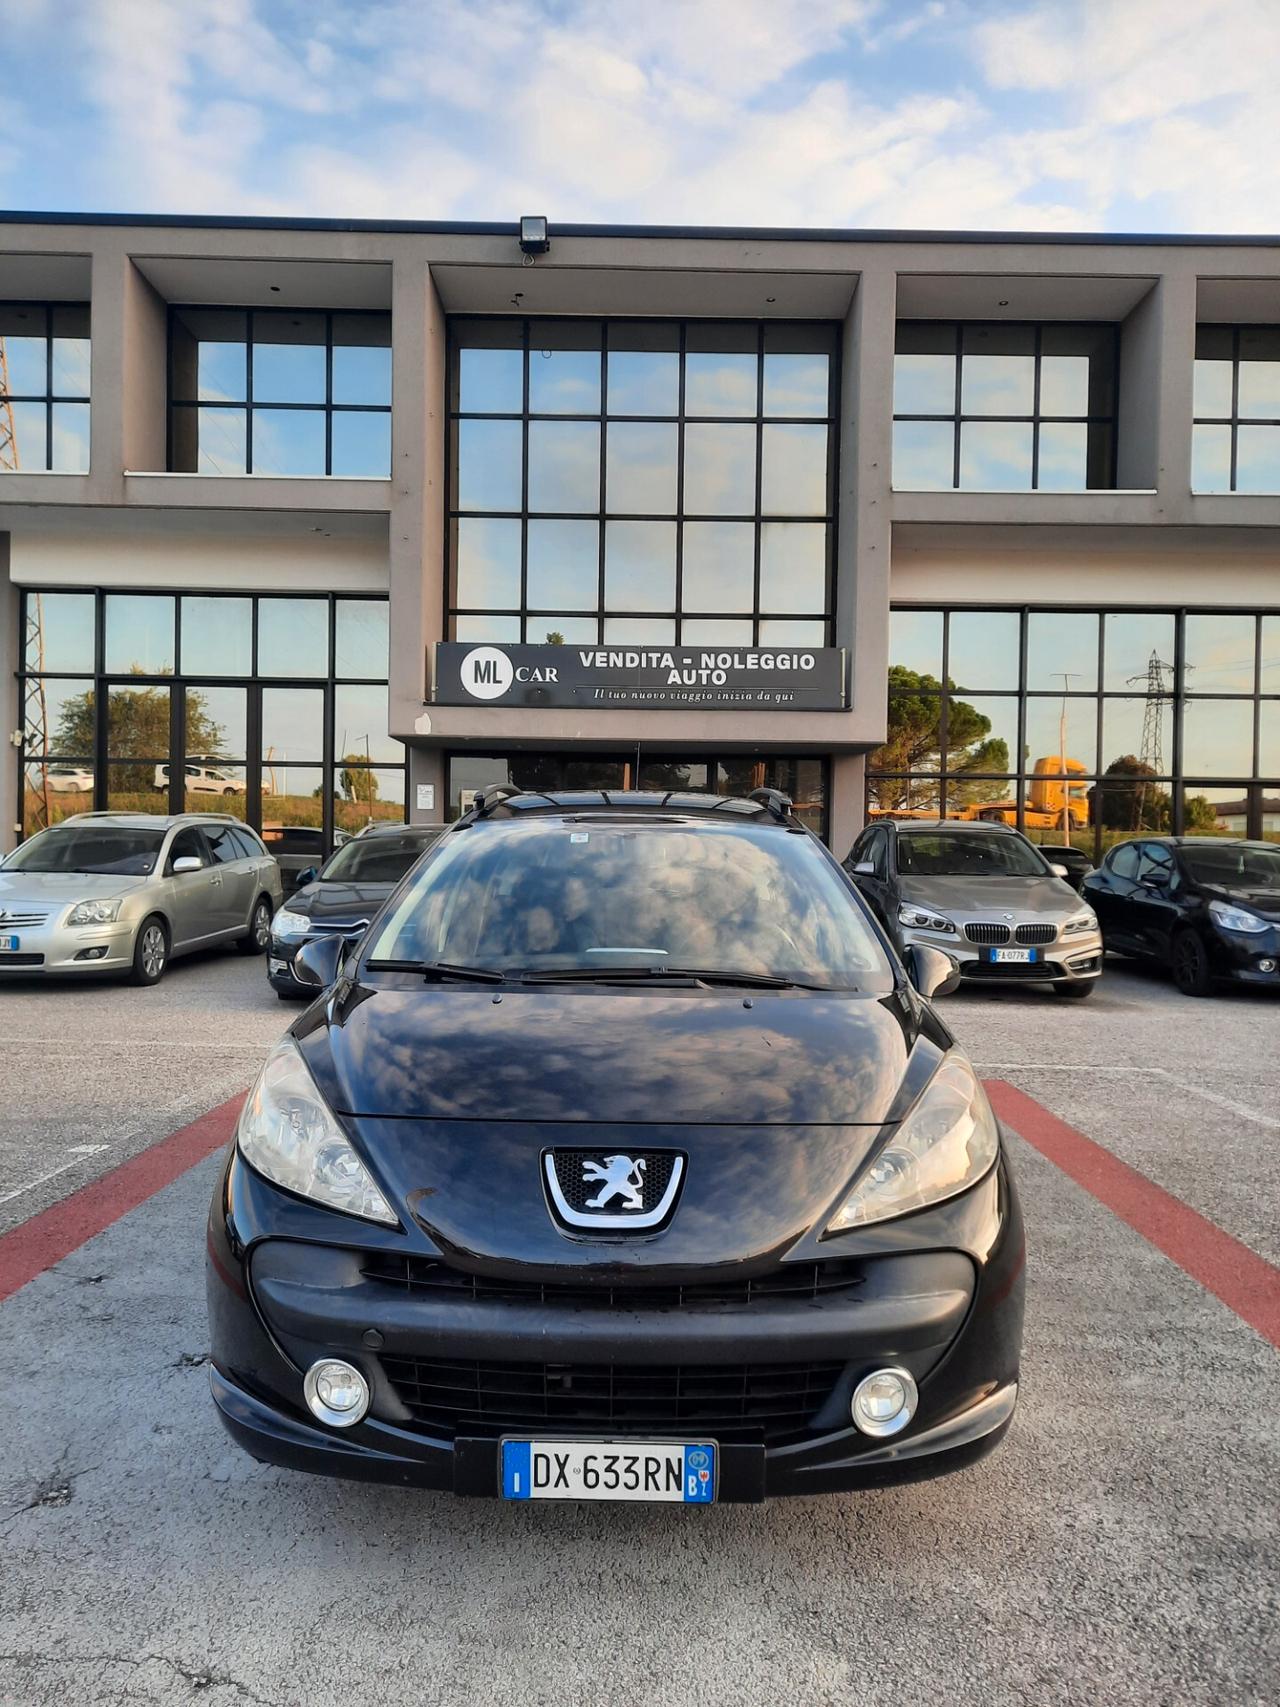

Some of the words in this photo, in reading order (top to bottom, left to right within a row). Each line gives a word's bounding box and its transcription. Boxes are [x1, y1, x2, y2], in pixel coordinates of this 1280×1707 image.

[579, 651, 675, 669] VENDITA
[701, 653, 815, 670] NOLEGGIO
[473, 660, 502, 684] ML
[515, 666, 559, 683] CAR
[667, 669, 727, 685] AUTO
[594, 688, 603, 699] Il
[608, 690, 627, 699] tuo
[631, 690, 666, 700] nuovo
[670, 690, 713, 702] viaggio
[717, 690, 752, 701] inizia
[756, 690, 771, 701] da
[775, 691, 794, 703] qui
